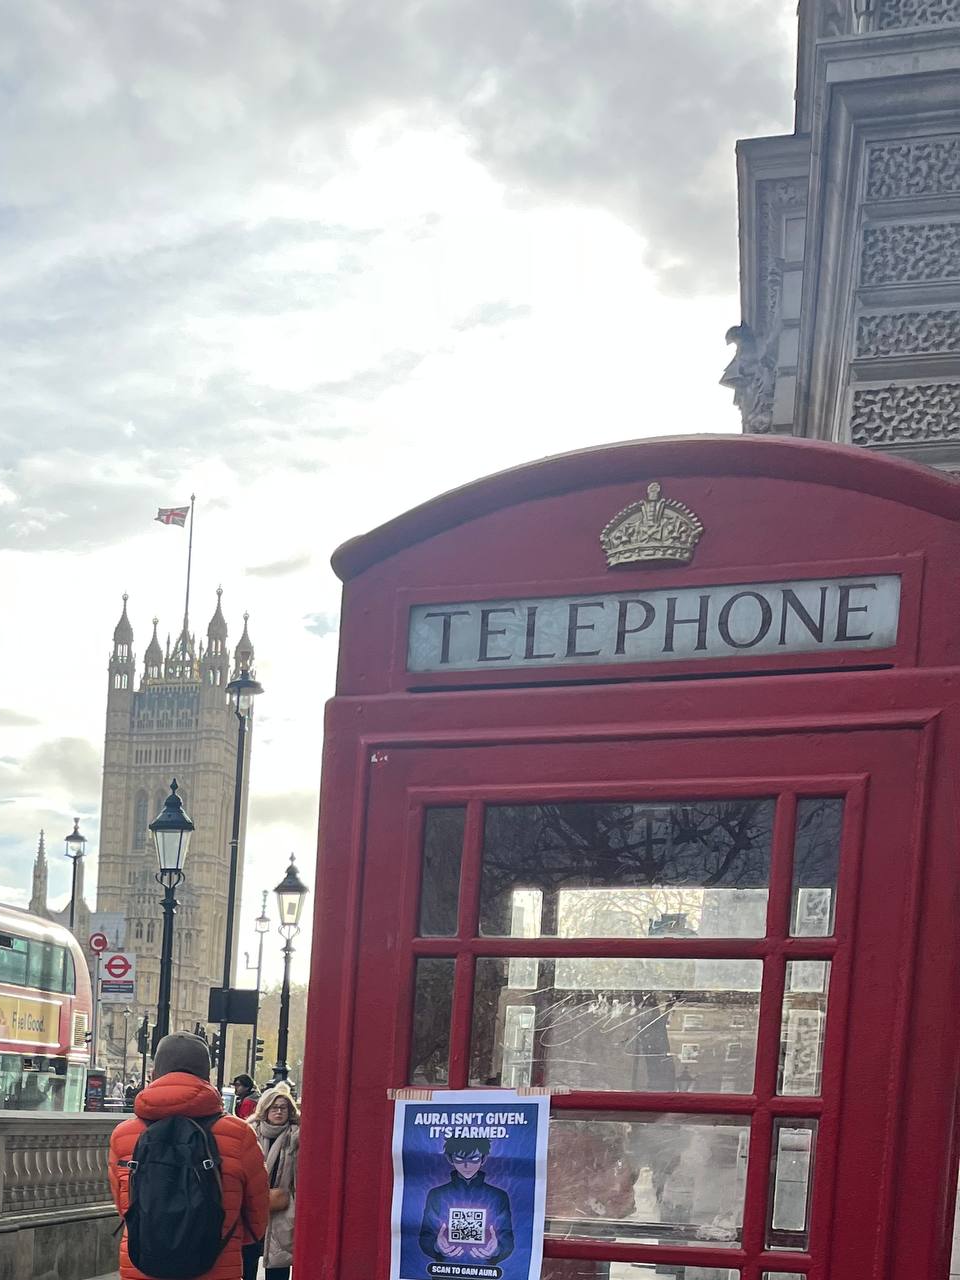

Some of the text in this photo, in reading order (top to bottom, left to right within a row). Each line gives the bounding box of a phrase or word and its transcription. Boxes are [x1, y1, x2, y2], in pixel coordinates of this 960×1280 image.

[425, 583, 878, 664] TELEPHONE
[414, 1112, 528, 1125] AURA ISN'T GIVEN.
[429, 1126, 509, 1139] IT'S FARMED.
[432, 1266, 498, 1277] SCAN TO GAIN AURA
